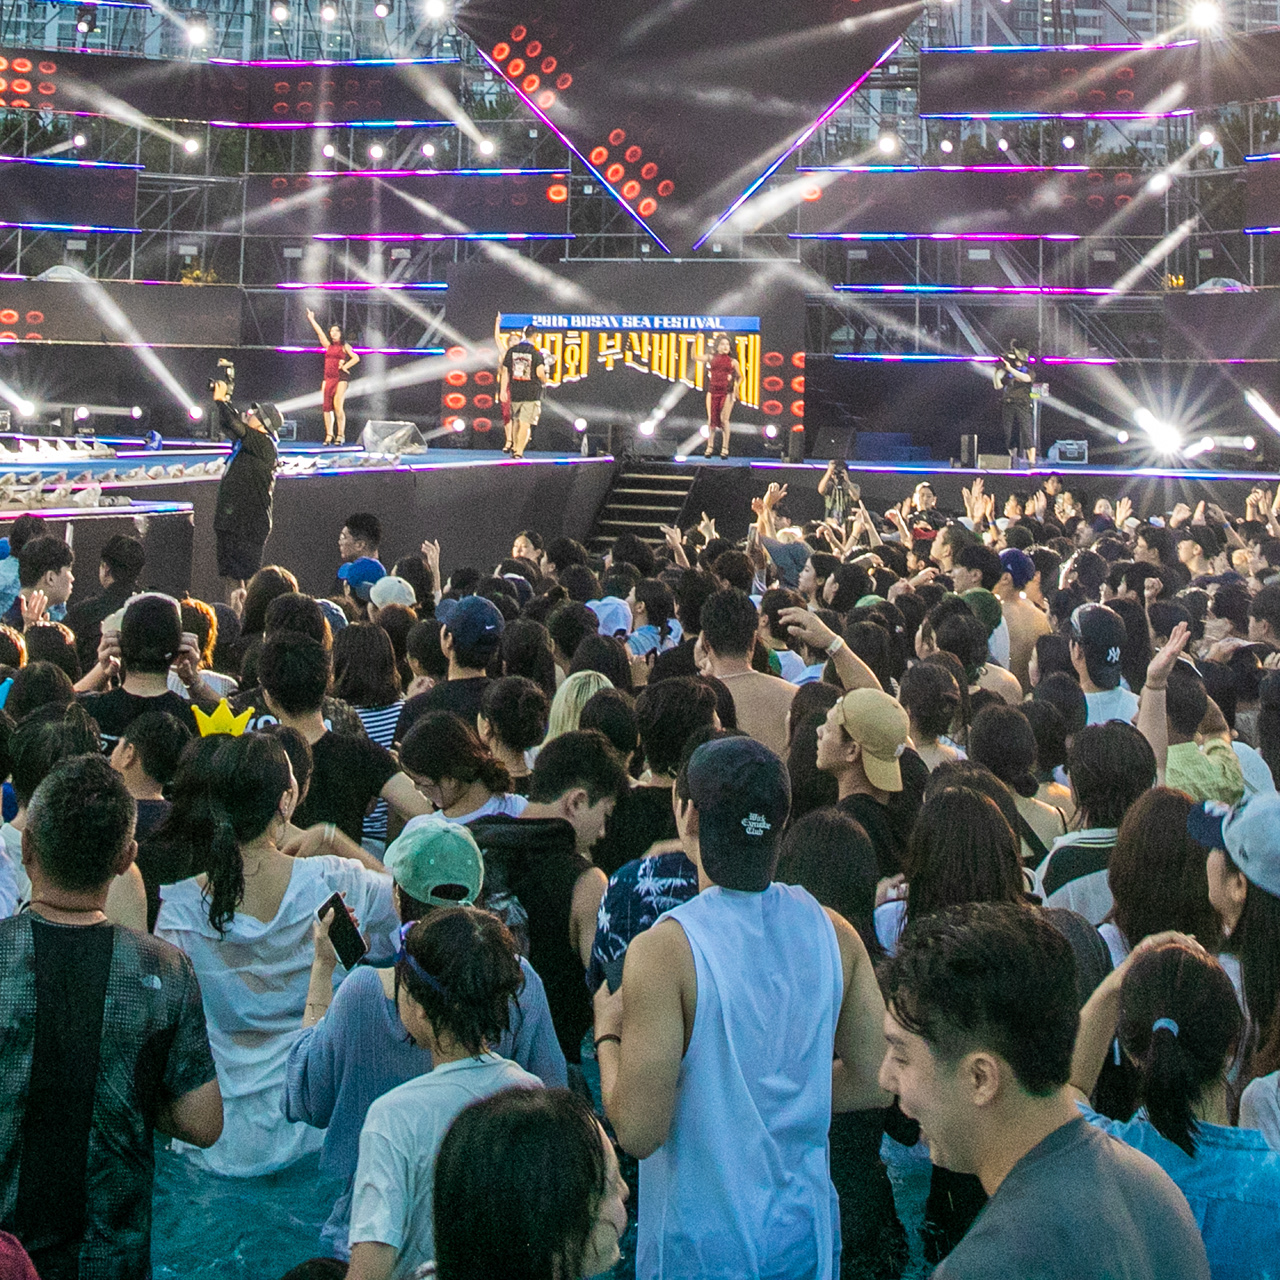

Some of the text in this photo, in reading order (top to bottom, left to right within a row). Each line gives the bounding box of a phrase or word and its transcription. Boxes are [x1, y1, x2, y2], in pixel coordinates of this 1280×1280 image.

[532, 315, 568, 328] 28th
[622, 316, 651, 329] SEA
[653, 316, 725, 329] FESTIVAL
